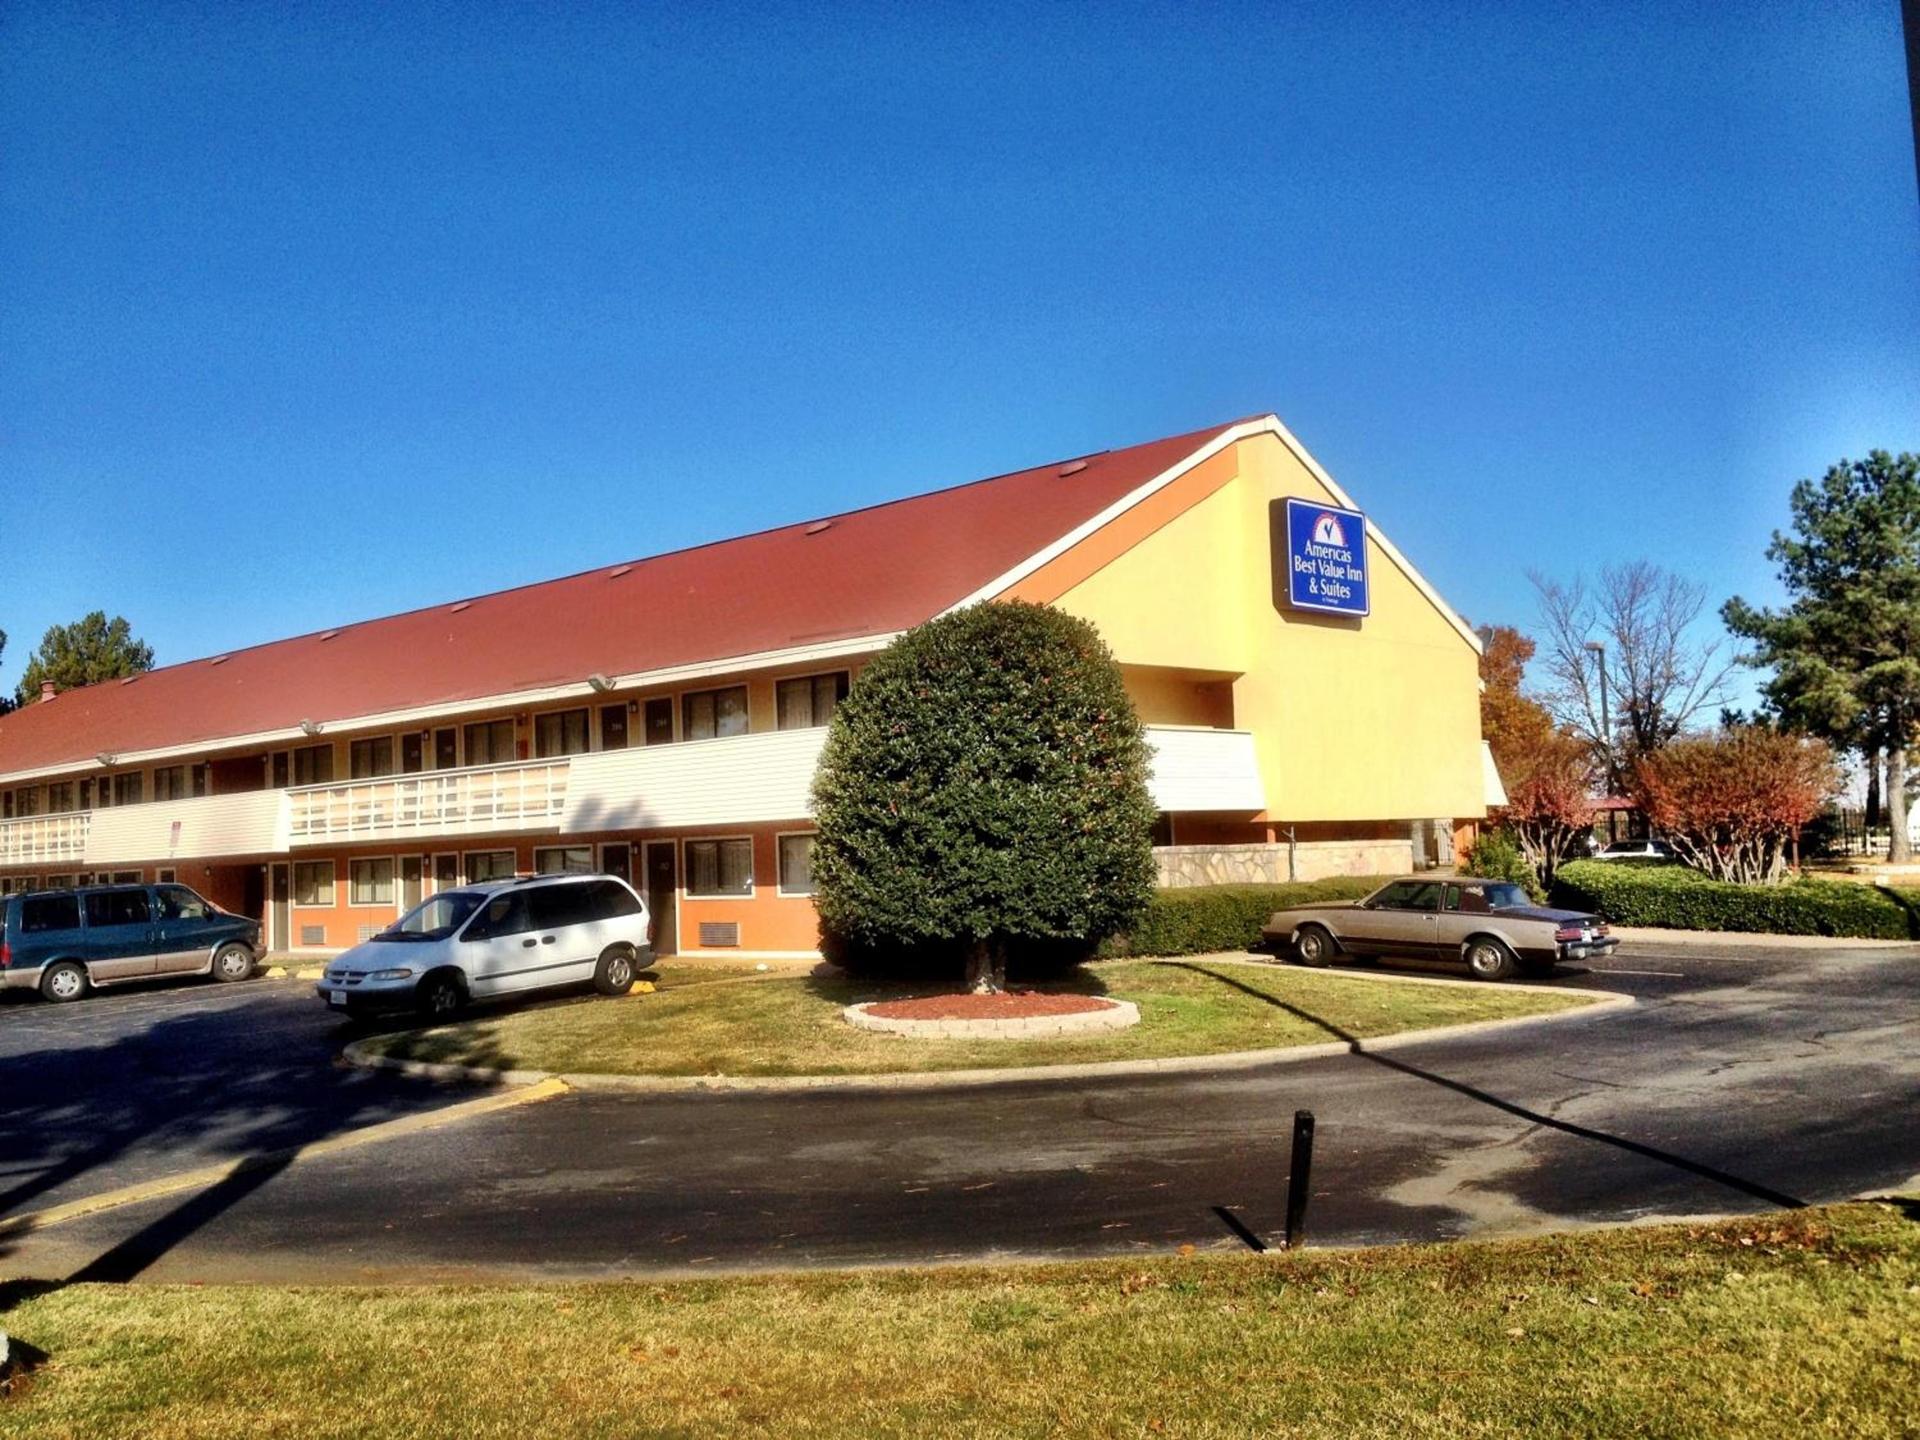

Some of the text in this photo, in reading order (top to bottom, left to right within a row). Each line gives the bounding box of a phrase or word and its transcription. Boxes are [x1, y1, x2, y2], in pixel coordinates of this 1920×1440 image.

[1305, 540, 1352, 563] Americas
[1294, 555, 1363, 582] Best Value Inn
[1309, 577, 1351, 599] & Suites
